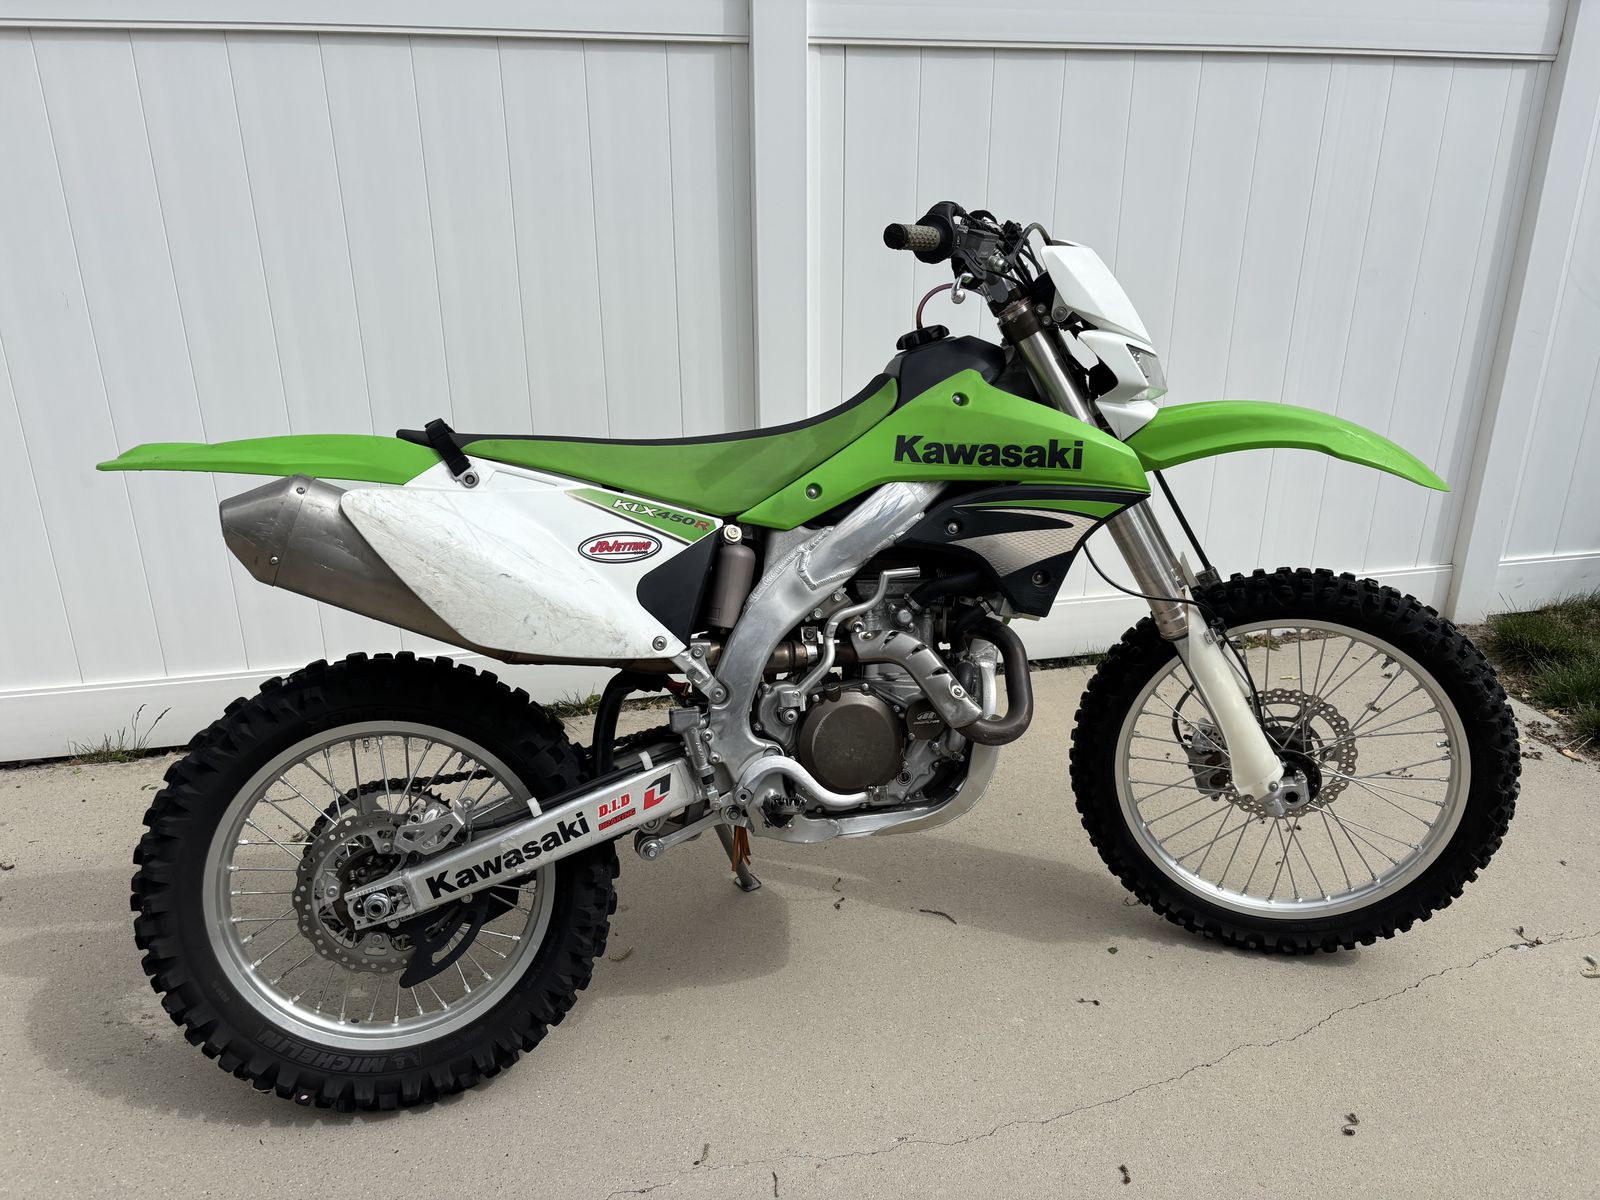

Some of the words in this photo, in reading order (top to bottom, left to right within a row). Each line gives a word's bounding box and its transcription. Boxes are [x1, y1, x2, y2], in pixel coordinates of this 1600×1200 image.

[894, 434, 1084, 470] Kawasaki
[612, 499, 710, 531] KLX450R
[598, 793, 631, 818] D.I.D
[598, 808, 637, 831] BRAKING
[425, 811, 590, 900] Kawasaki
[257, 1030, 387, 1073] MICHELIN
